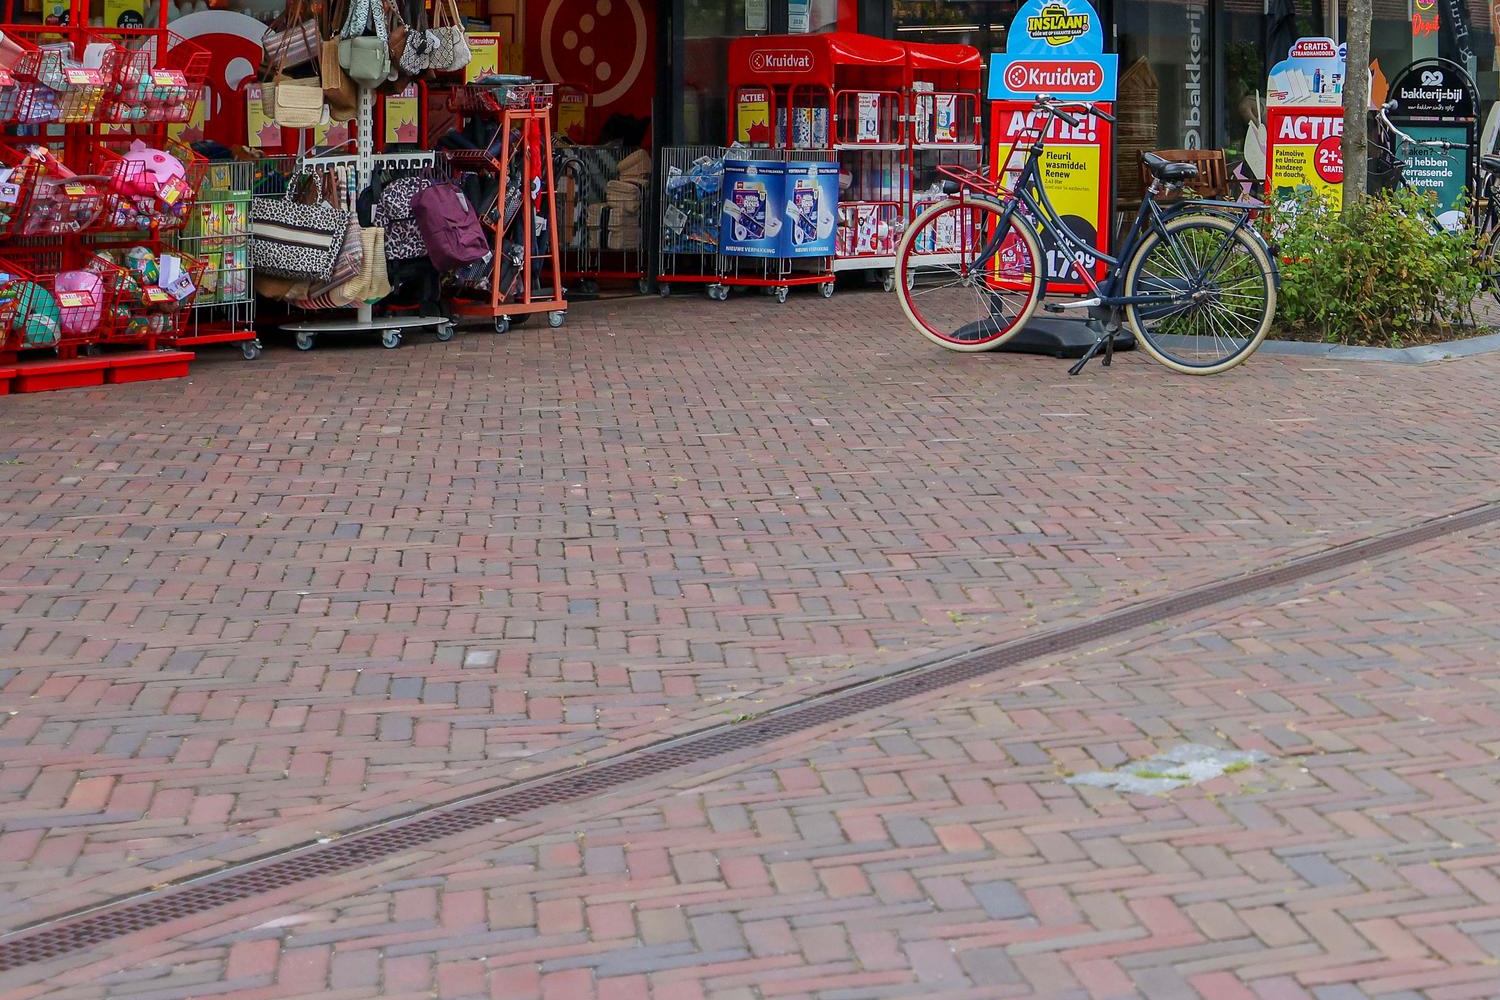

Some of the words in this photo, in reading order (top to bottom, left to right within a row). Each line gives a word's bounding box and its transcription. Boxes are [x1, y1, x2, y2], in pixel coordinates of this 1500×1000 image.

[1028, 14, 1088, 31] INSLAAN!
[1303, 42, 1328, 51] GRATIS
[765, 54, 810, 68] Kruidvat
[1185, 3, 1205, 127] bakkerij
[1028, 67, 1096, 86] Kruidvat
[740, 93, 765, 102] ACTIE!
[1007, 110, 1097, 141] ACTIE!
[1046, 151, 1071, 161] Fleuril
[1275, 150, 1305, 158] Palmolive
[1402, 147, 1434, 156] aken?
[1045, 160, 1087, 171] wasmiddel
[1415, 157, 1448, 167] hebben
[1275, 164, 1303, 172] handzeep
[1401, 168, 1453, 178] verrassende
[1045, 170, 1071, 179] Renew
[1401, 177, 1444, 188] akketten
[1046, 249, 1096, 279] 17.99
